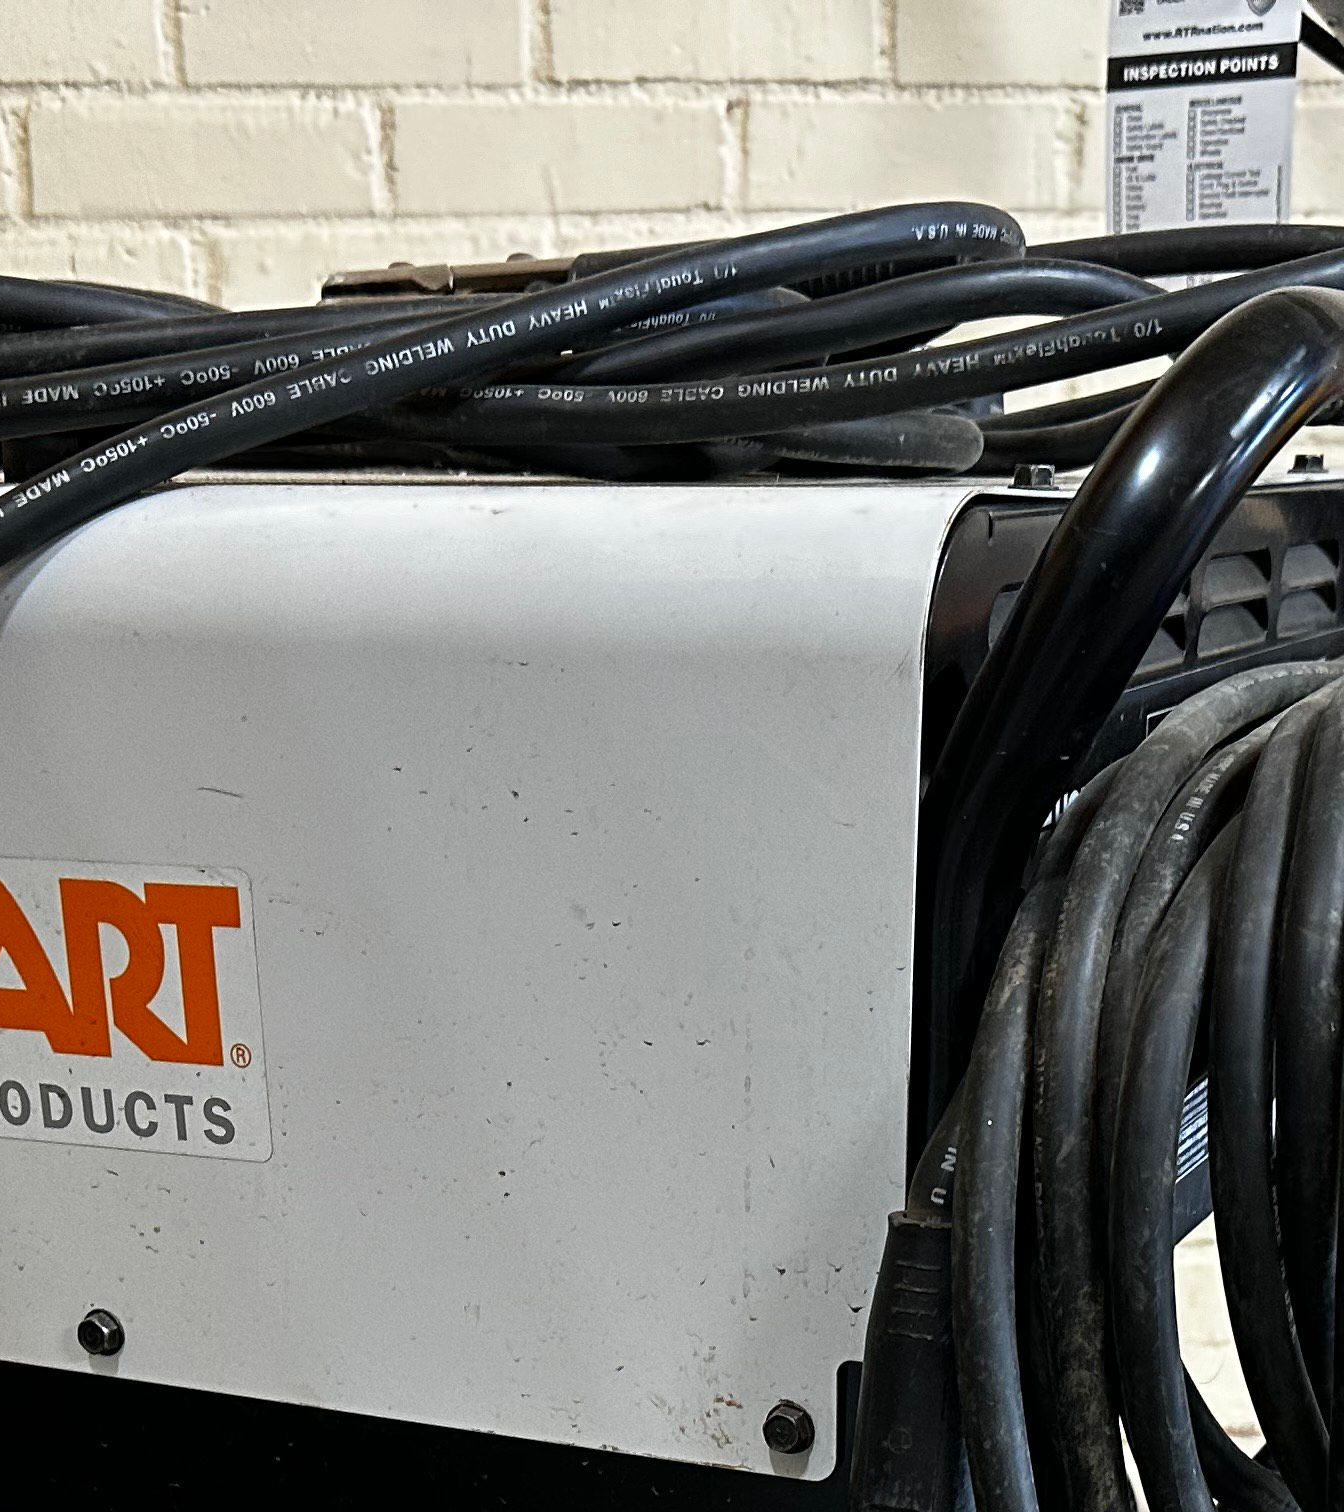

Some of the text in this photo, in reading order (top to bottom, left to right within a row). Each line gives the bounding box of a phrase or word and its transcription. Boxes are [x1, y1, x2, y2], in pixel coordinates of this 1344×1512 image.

[1123, 53, 1279, 82] INSPECTION POINTS
[528, 300, 588, 332] HEAVY
[1133, 317, 1163, 339] 1/0
[466, 320, 516, 348] DUTY
[253, 354, 300, 376] 600V
[364, 337, 455, 376] WELDING
[912, 353, 980, 378] HEAVY
[285, 368, 353, 400] CABLE
[737, 376, 830, 399] WELDING
[842, 366, 898, 389] DUTY
[22, 384, 79, 405] MADE
[230, 391, 276, 417] 600V
[660, 383, 725, 402] CABLE
[15, 469, 71, 508] MADE
[941, 1146, 957, 1172] IN
